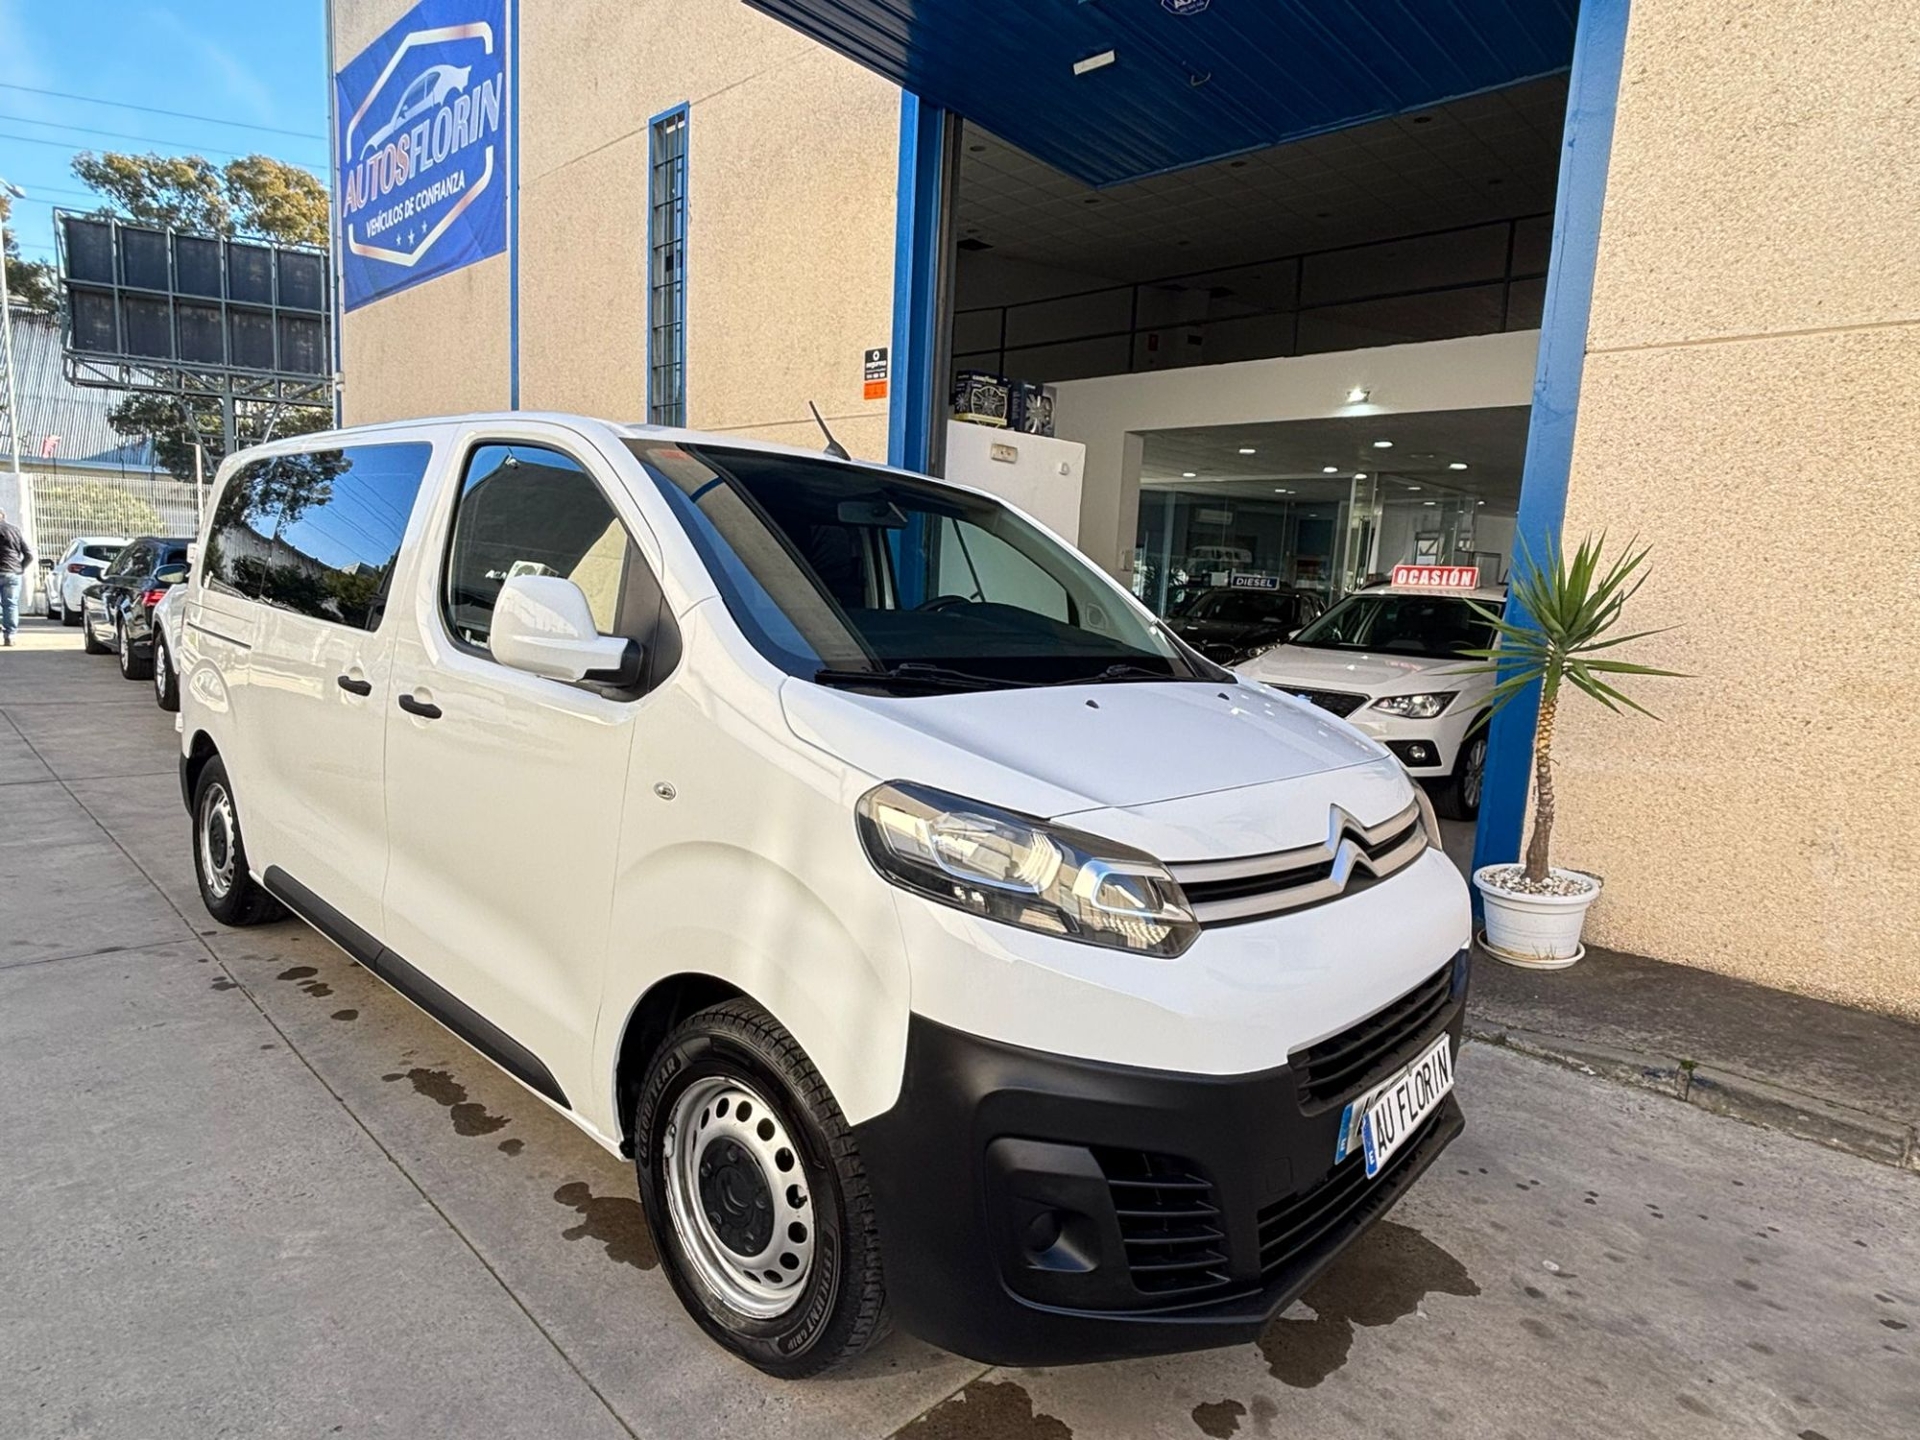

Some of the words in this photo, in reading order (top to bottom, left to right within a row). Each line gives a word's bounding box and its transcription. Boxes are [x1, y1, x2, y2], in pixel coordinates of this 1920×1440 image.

[343, 73, 502, 217] AUTOSFLORIN
[366, 203, 403, 238] VEHÍCULOS
[404, 197, 414, 219] DE
[415, 170, 465, 212] CONFIANZA
[1236, 577, 1273, 587] DIESEL
[1397, 567, 1472, 586] OCASIÓN
[1375, 1097, 1395, 1158] AU
[1396, 1046, 1449, 1131] FLORIN
[1368, 1150, 1375, 1165] E
